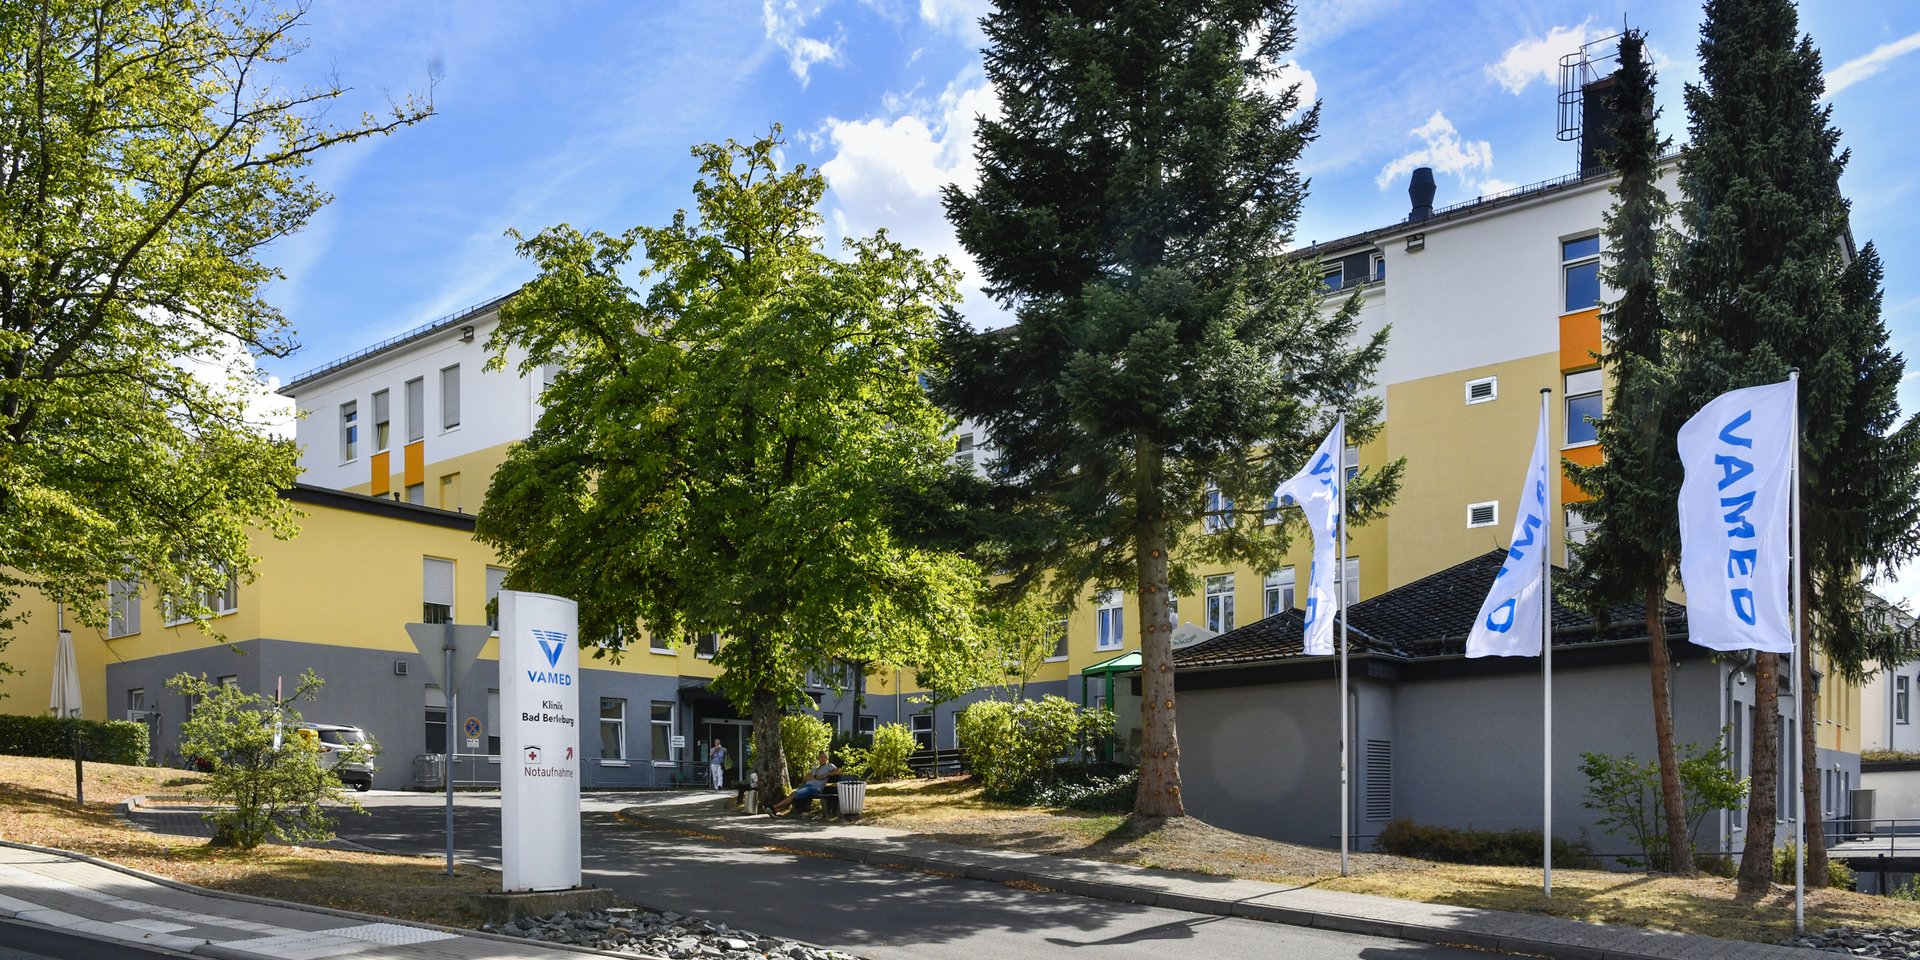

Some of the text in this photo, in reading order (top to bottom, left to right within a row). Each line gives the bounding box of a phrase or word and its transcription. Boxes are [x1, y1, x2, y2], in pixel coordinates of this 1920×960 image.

[1714, 409, 1758, 626] VAMED
[527, 670, 572, 686] VAMED
[542, 700, 564, 711] Klinik
[521, 713, 574, 727] Bad Berleburg
[524, 766, 573, 778] Notaufnahme
